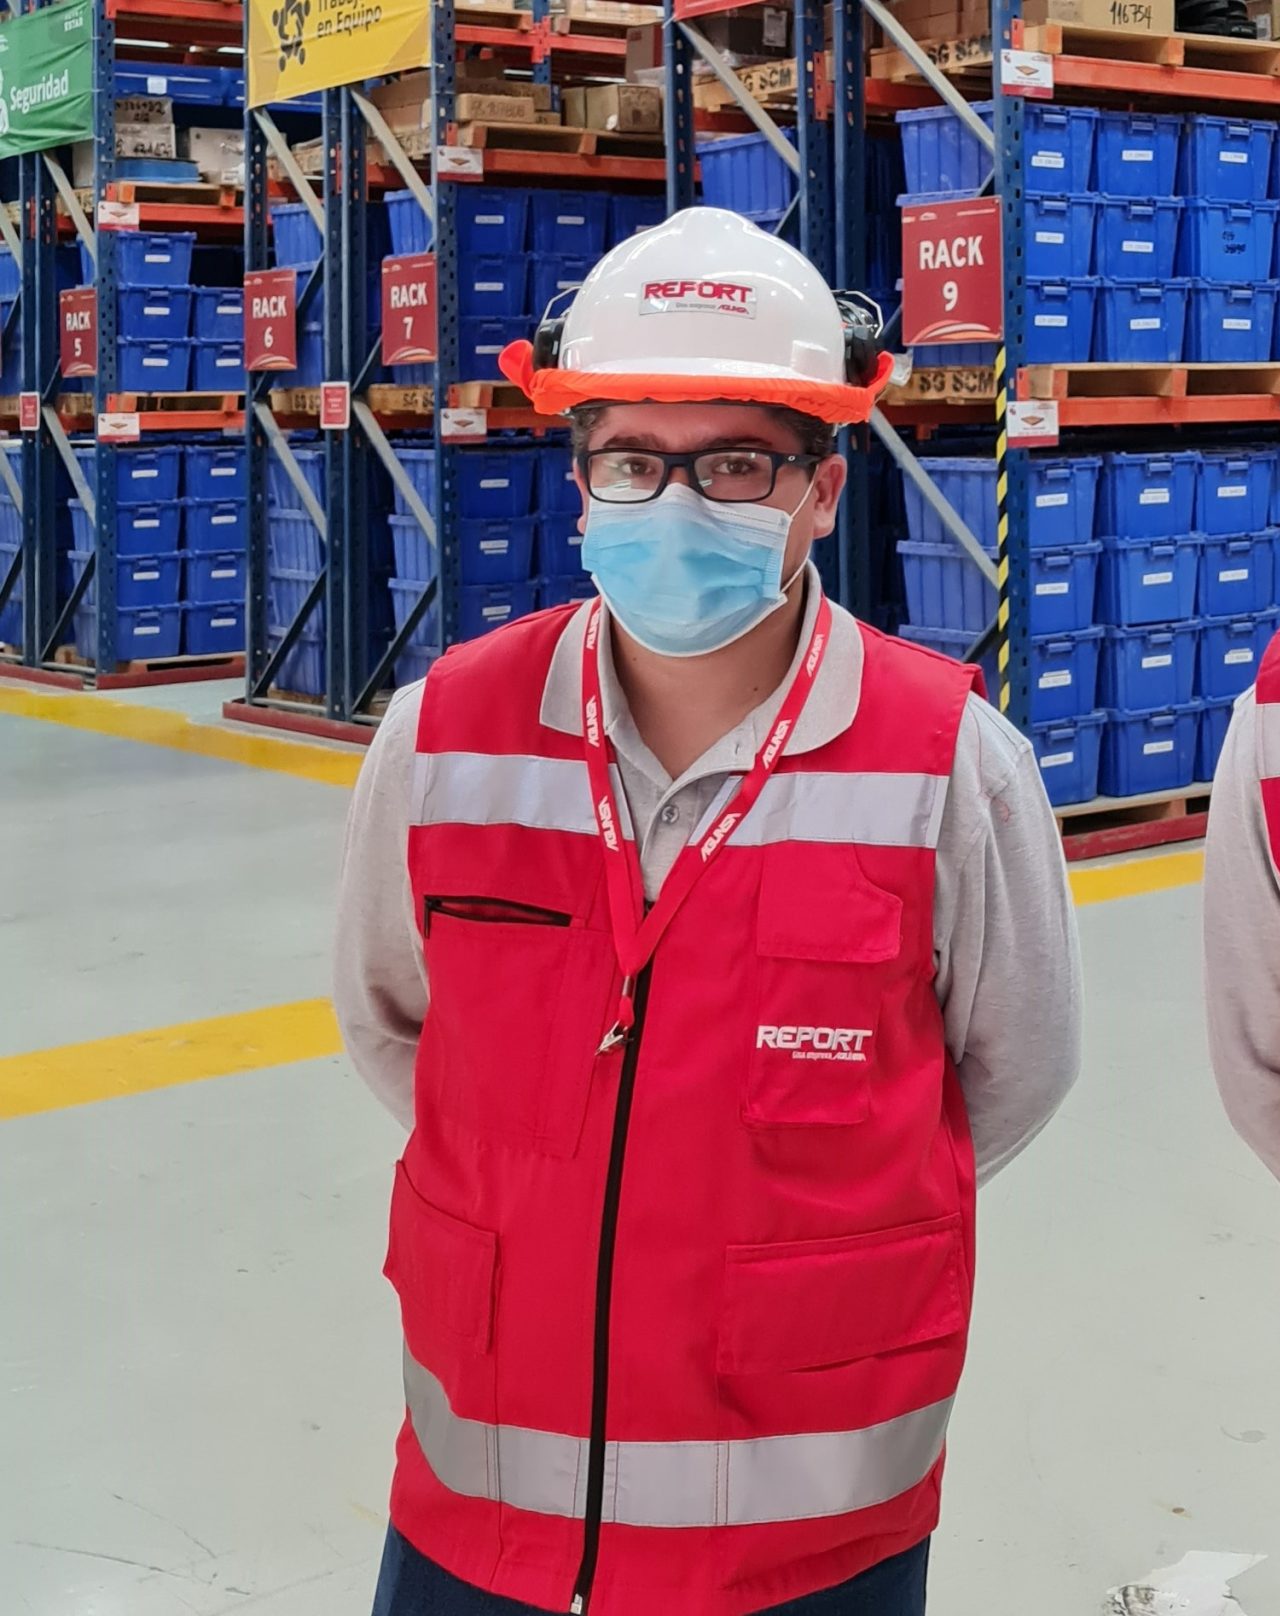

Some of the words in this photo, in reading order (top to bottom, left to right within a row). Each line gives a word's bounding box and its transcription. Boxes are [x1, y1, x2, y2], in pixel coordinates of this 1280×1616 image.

[317, 19, 333, 38] en
[336, 4, 382, 36] Equipo
[1110, 0, 1152, 29] 116754
[10, 69, 69, 113] Seguridad
[759, 66, 792, 90] SCM
[919, 235, 984, 271] RACK
[252, 295, 287, 320] RACK
[390, 282, 428, 309] RACK
[942, 280, 959, 312] 9
[65, 310, 91, 331] RACK
[403, 316, 414, 339] 7
[74, 338, 82, 357] 5
[263, 327, 274, 349] 6
[952, 370, 994, 393] SCM
[805, 633, 825, 677] AGUNSA
[585, 695, 600, 748] AGUNSA
[761, 719, 792, 770] AGUNSA
[597, 795, 620, 852] AGUNSA
[701, 812, 742, 863] AGUNSA
[756, 1025, 873, 1051] REPORT
